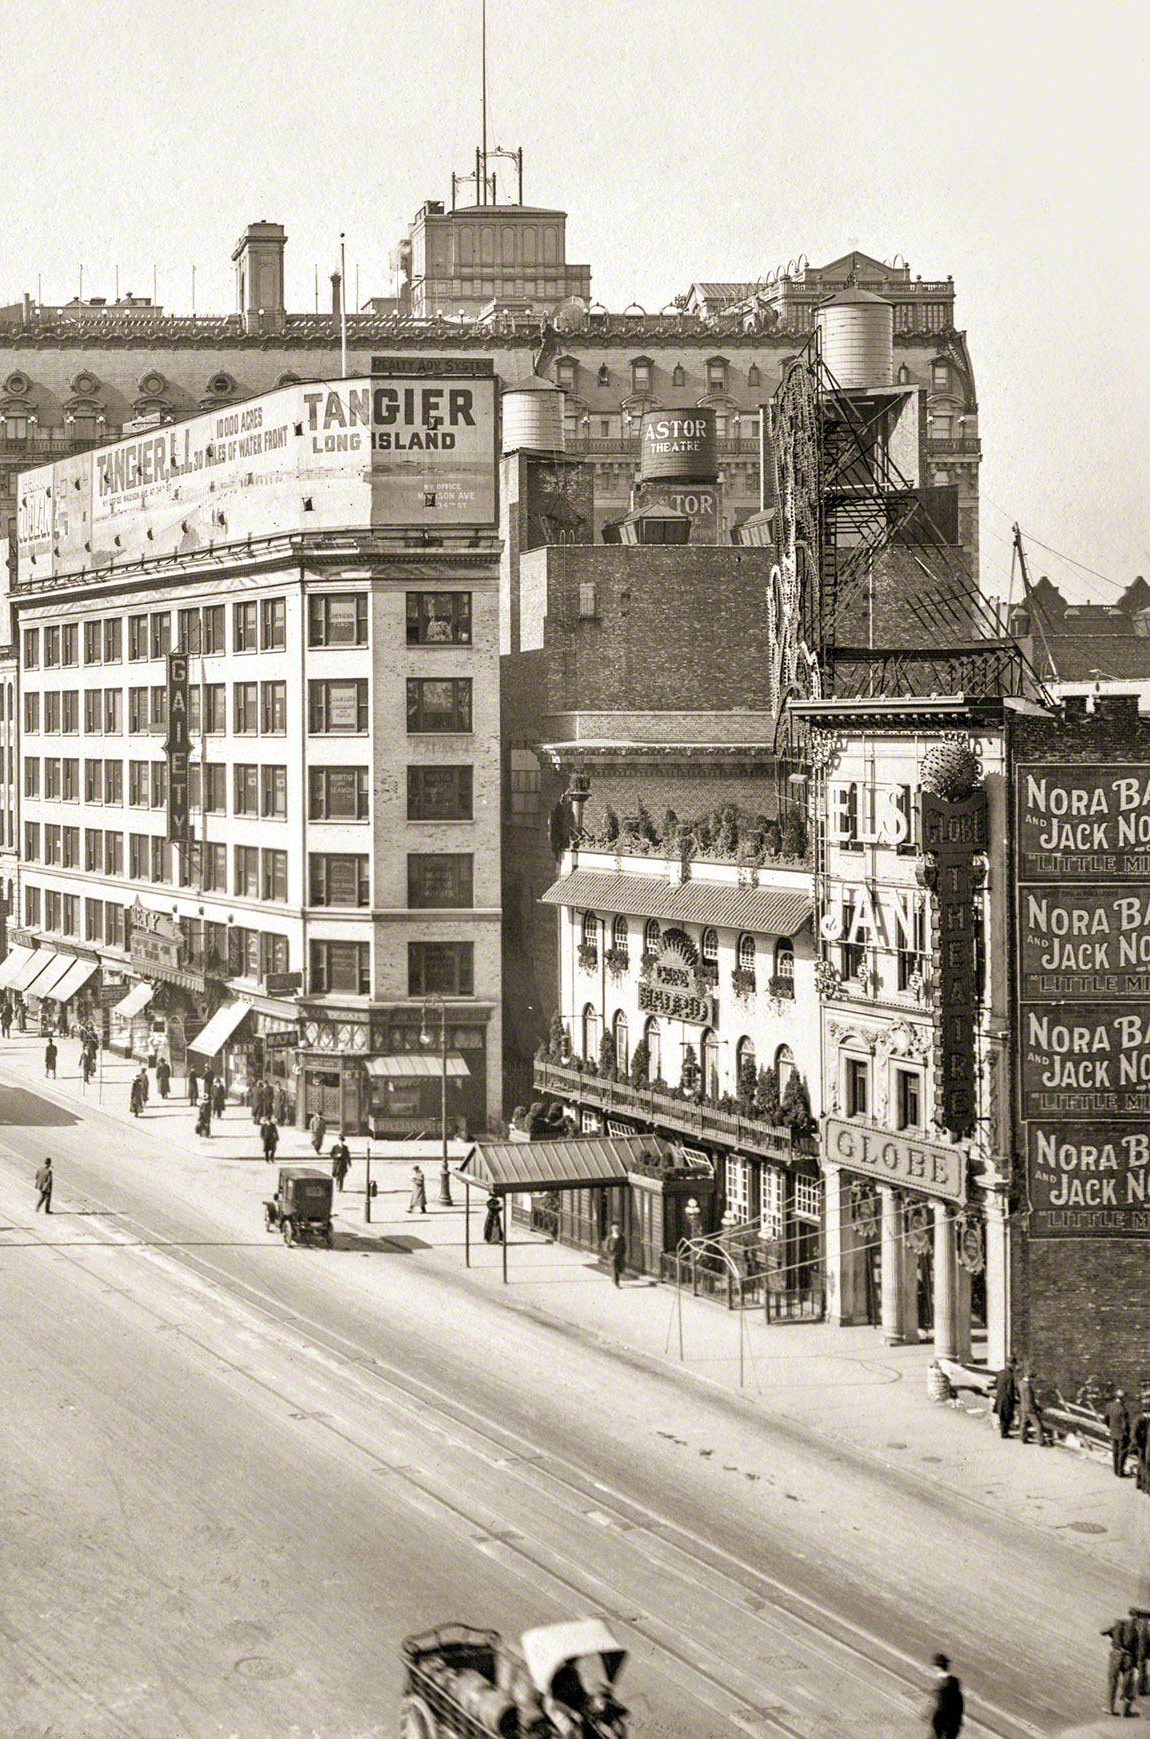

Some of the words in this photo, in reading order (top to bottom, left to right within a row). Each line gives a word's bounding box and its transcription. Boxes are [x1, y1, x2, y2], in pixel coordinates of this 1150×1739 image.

[372, 358, 415, 372] REALTY
[241, 406, 263, 433] ACRES
[303, 388, 476, 431] TANGIER
[194, 449, 203, 472] 30
[228, 440, 237, 462] OF
[238, 431, 263, 460] WATER
[264, 424, 288, 453] FRONT
[312, 433, 362, 454] LONG
[372, 432, 456, 450] ISLAND
[645, 419, 707, 441] ASTOR
[650, 440, 701, 454] THEATRE
[457, 491, 475, 500] AVE
[171, 659, 186, 836] GAIETY
[829, 782, 908, 845] ELS
[1026, 774, 1109, 816] NORA
[925, 807, 985, 845] GLOBE
[1025, 814, 1047, 828] AND
[1040, 817, 1109, 850] JACK
[1027, 894, 1110, 936] NORA
[1027, 934, 1048, 948] AND
[1041, 937, 1110, 971] JACK
[1028, 1012, 1111, 1054] NORA
[1027, 1052, 1050, 1066] AND
[1042, 1054, 1110, 1088] JACK
[838, 1130, 949, 1184] GLOBE
[1036, 1130, 1119, 1172] NORA
[1035, 1170, 1057, 1184] AND
[1050, 1173, 1118, 1207] JACK
